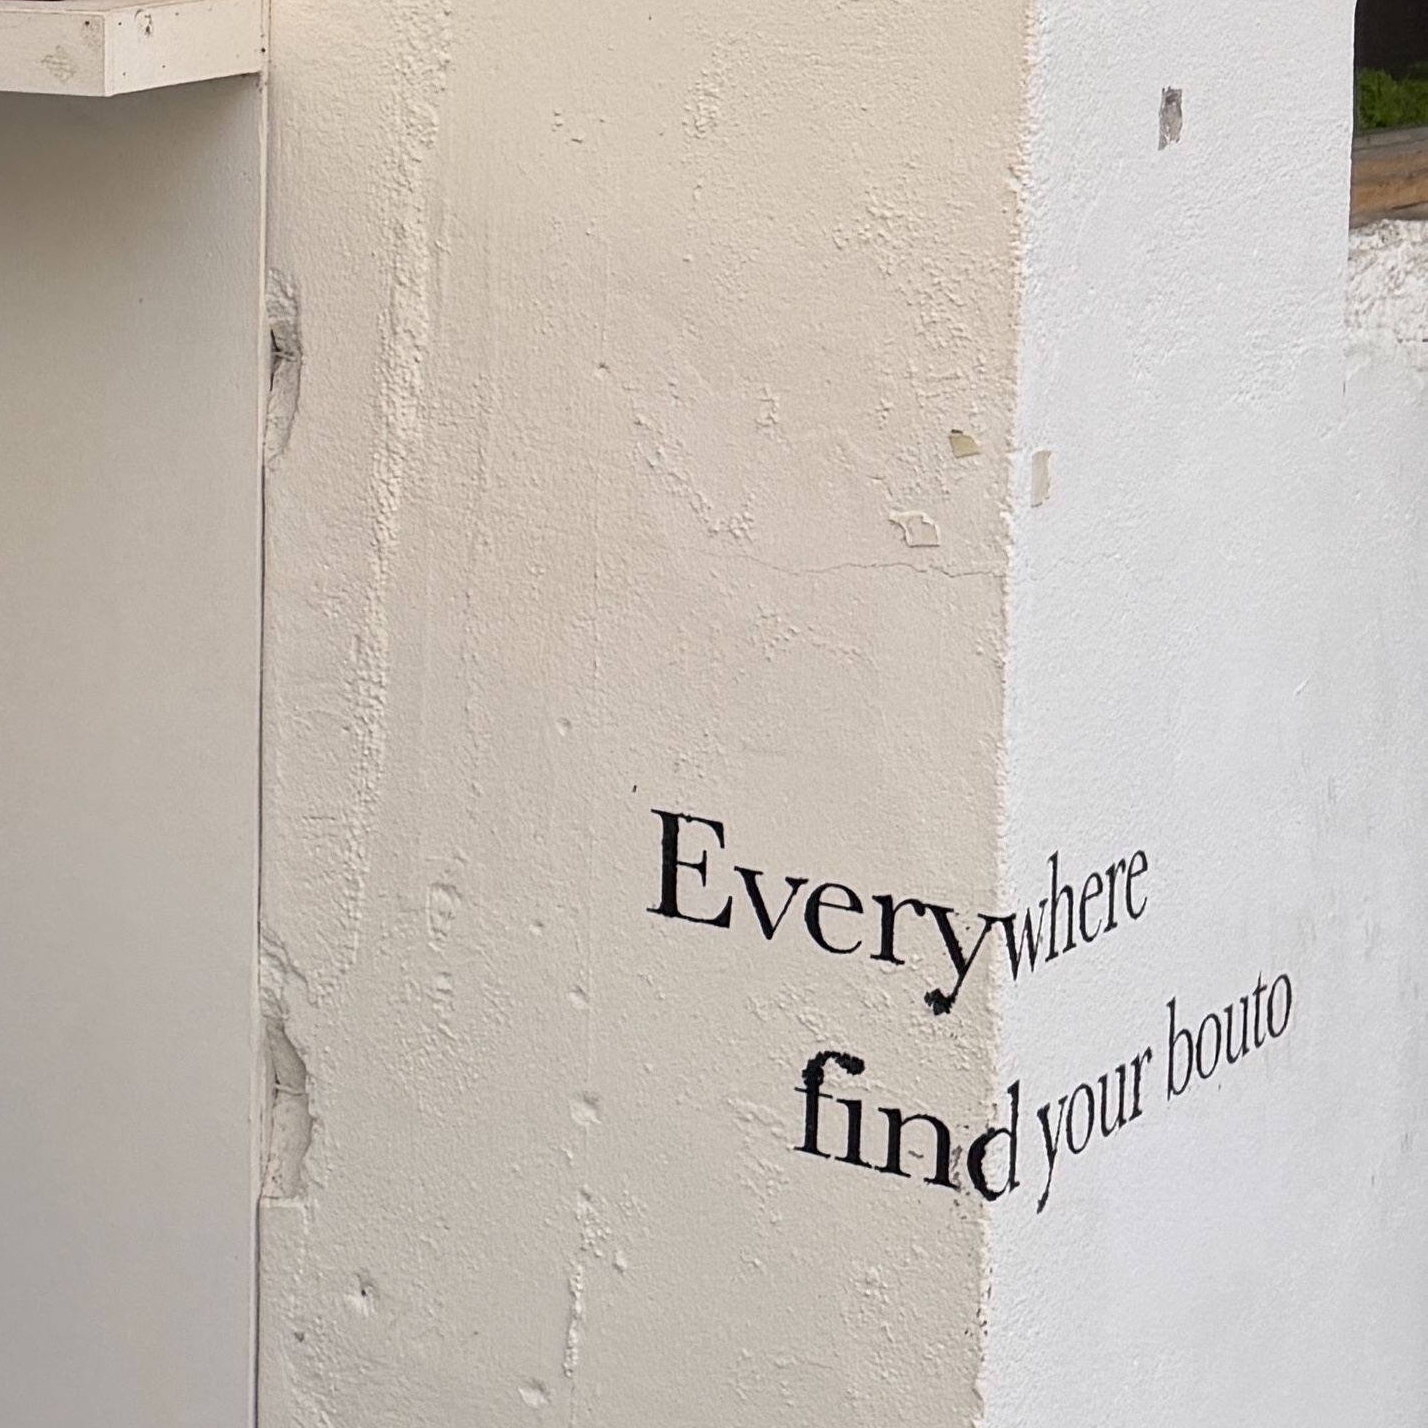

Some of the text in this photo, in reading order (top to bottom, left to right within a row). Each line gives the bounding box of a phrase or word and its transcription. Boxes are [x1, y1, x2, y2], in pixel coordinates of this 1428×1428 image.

[647, 808, 1150, 1016] Everywhere
[792, 970, 1294, 1215] find your bouto
